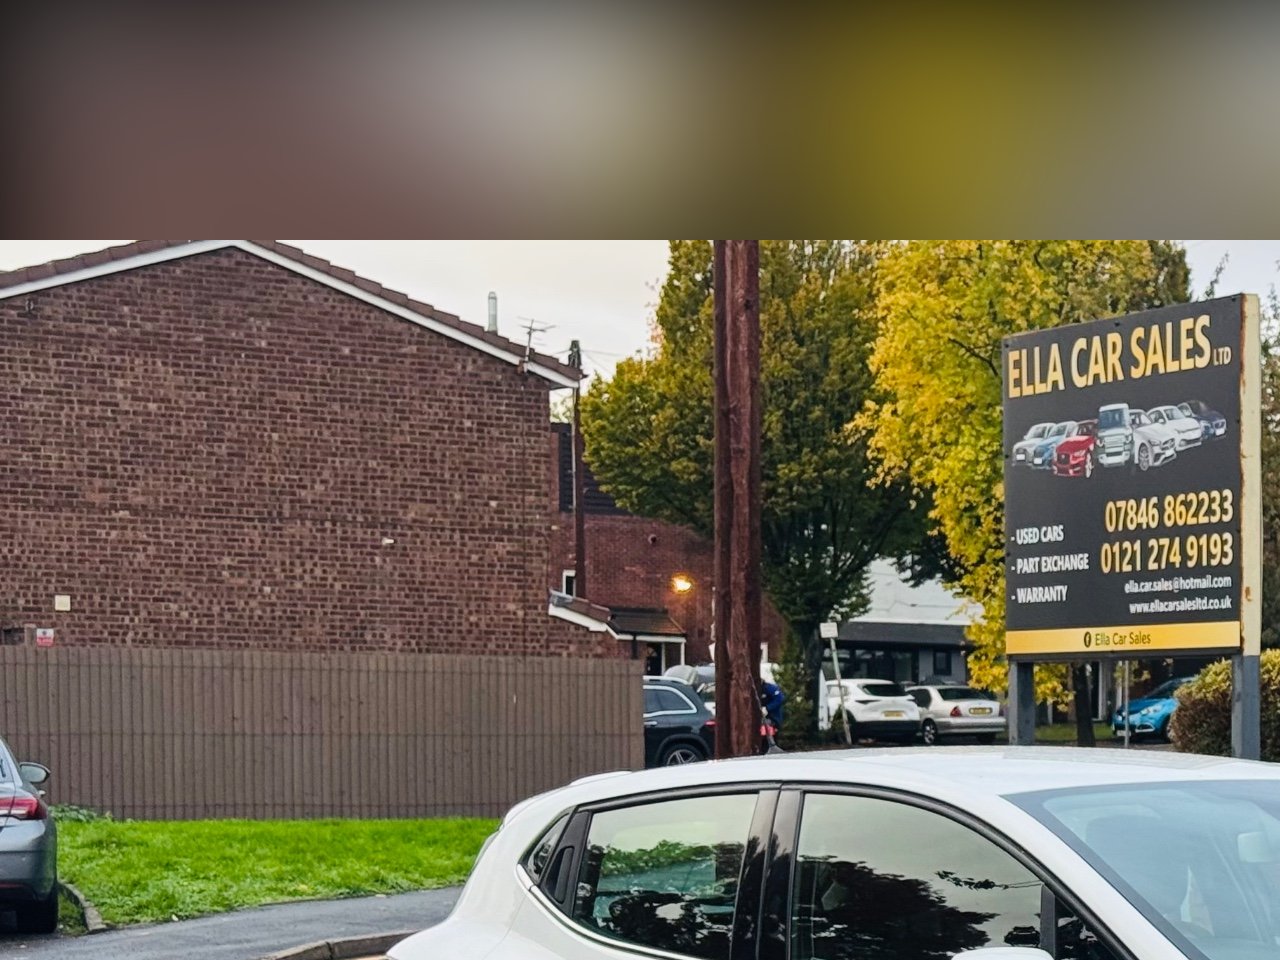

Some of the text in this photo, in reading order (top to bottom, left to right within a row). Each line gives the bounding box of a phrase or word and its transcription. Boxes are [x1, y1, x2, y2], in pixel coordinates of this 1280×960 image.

[1008, 314, 1231, 399] ELLA CAR SALES LTD
[1104, 489, 1233, 533] 07846 862233
[1016, 524, 1064, 545] USED CARS
[1100, 532, 1233, 574] 0121 274 9193
[1016, 553, 1089, 575] PART EXCHANGE
[1016, 585, 1067, 603] WARRANTY
[1124, 574, 1232, 594] ella.car.sales@hotmail.com
[1129, 595, 1232, 614] www.ellacarsalesltd.co.uk
[1095, 631, 1151, 646] Ella Car Sales
